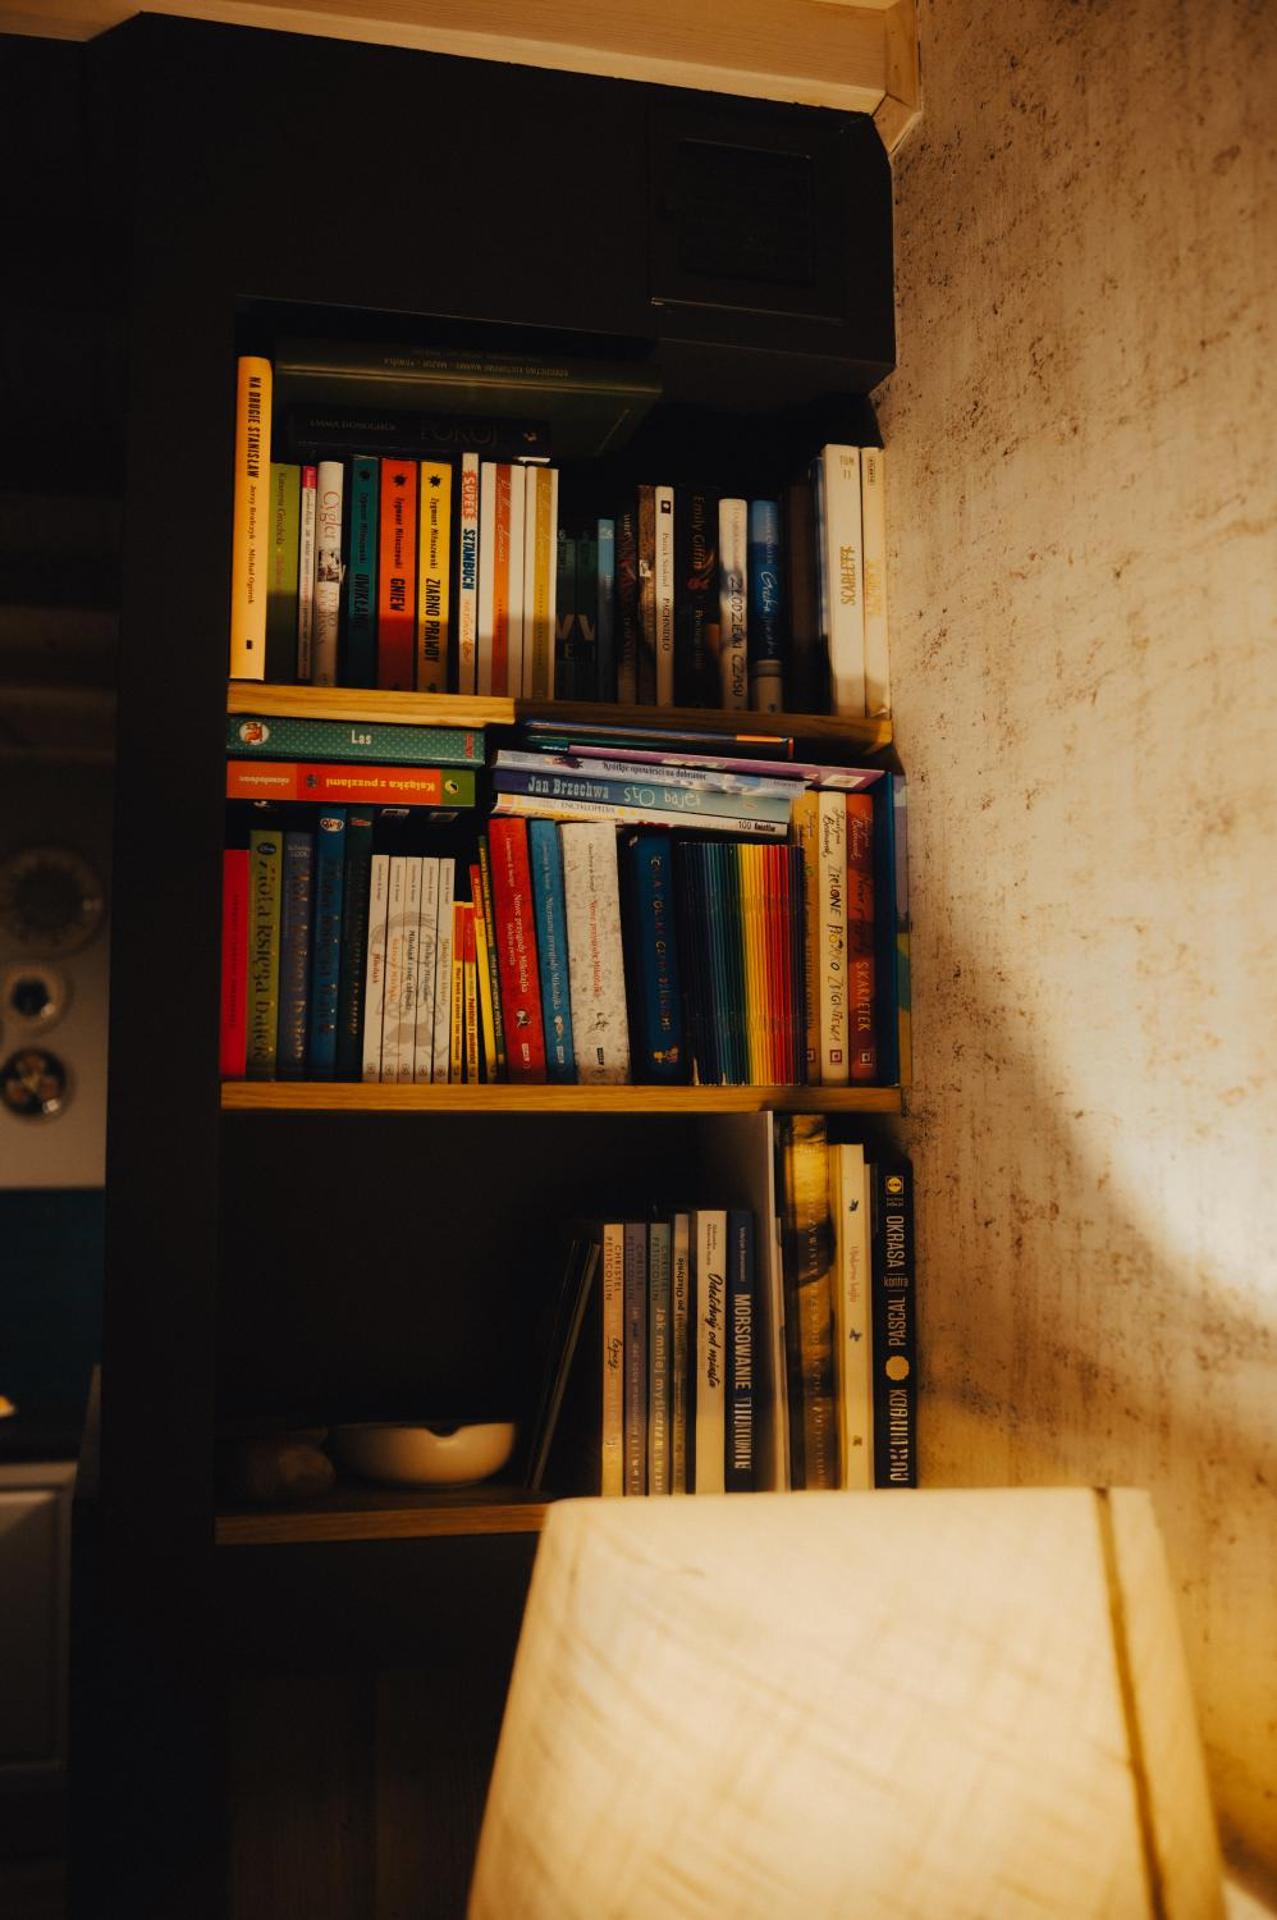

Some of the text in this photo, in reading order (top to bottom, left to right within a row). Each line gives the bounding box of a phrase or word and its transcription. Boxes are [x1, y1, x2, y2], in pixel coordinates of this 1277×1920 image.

[246, 376, 261, 479] NA DRUGIE STANISŁAW
[247, 484, 258, 505] Jerzy
[320, 491, 341, 540] Cygler
[463, 476, 476, 517] SUPER
[275, 508, 287, 545] Grochola
[429, 497, 440, 569] Zygmunt Miłoszewski
[247, 548, 258, 576] Michał
[461, 528, 476, 590] SZTAMBUCH
[390, 577, 405, 612] GNIEW
[425, 577, 440, 663] ZIARNO PRAWDY
[731, 654, 745, 697] CZASU
[350, 728, 373, 745] Las
[325, 777, 379, 791] puzzlami
[388, 779, 436, 792] Książka
[528, 775, 609, 799] Jan Brzechwa
[623, 785, 656, 806] sto
[738, 820, 751, 830] 100
[513, 893, 530, 993] Nowe przygody Mikołajka
[855, 960, 873, 1033] SKARPETEK
[886, 1215, 905, 1268] OKRASA
[605, 1236, 614, 1301] PETITCOLLIN
[614, 1244, 622, 1292] CHRISTEL
[675, 1256, 685, 1298] Olsztynie
[654, 1307, 666, 1330] Jak
[703, 1272, 724, 1328] Odetchnij
[708, 1331, 722, 1345] od
[733, 1293, 752, 1391] MORSOWANIE
[888, 1297, 906, 1347] PASCAL
[653, 1334, 667, 1374] mniej
[706, 1347, 722, 1389] miasta
